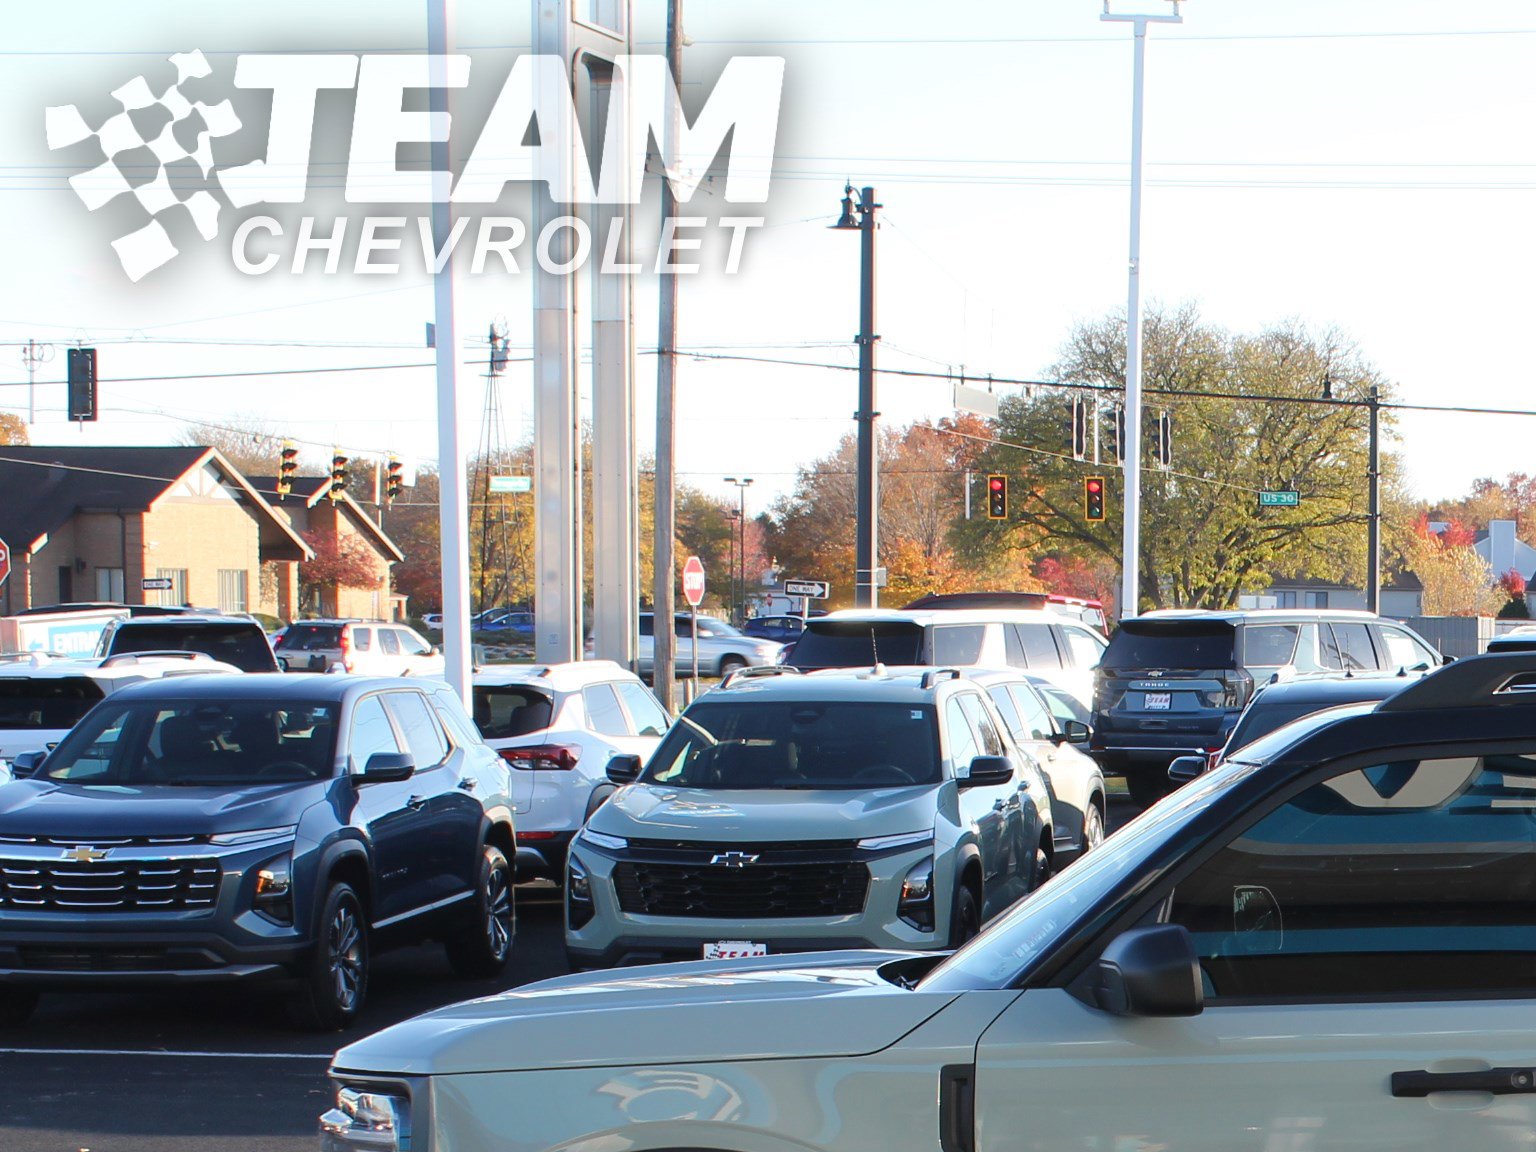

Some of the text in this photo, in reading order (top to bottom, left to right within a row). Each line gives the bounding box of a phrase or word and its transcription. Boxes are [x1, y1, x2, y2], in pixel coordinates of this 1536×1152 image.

[1263, 494, 1294, 503] US 30
[685, 572, 704, 590] STOP
